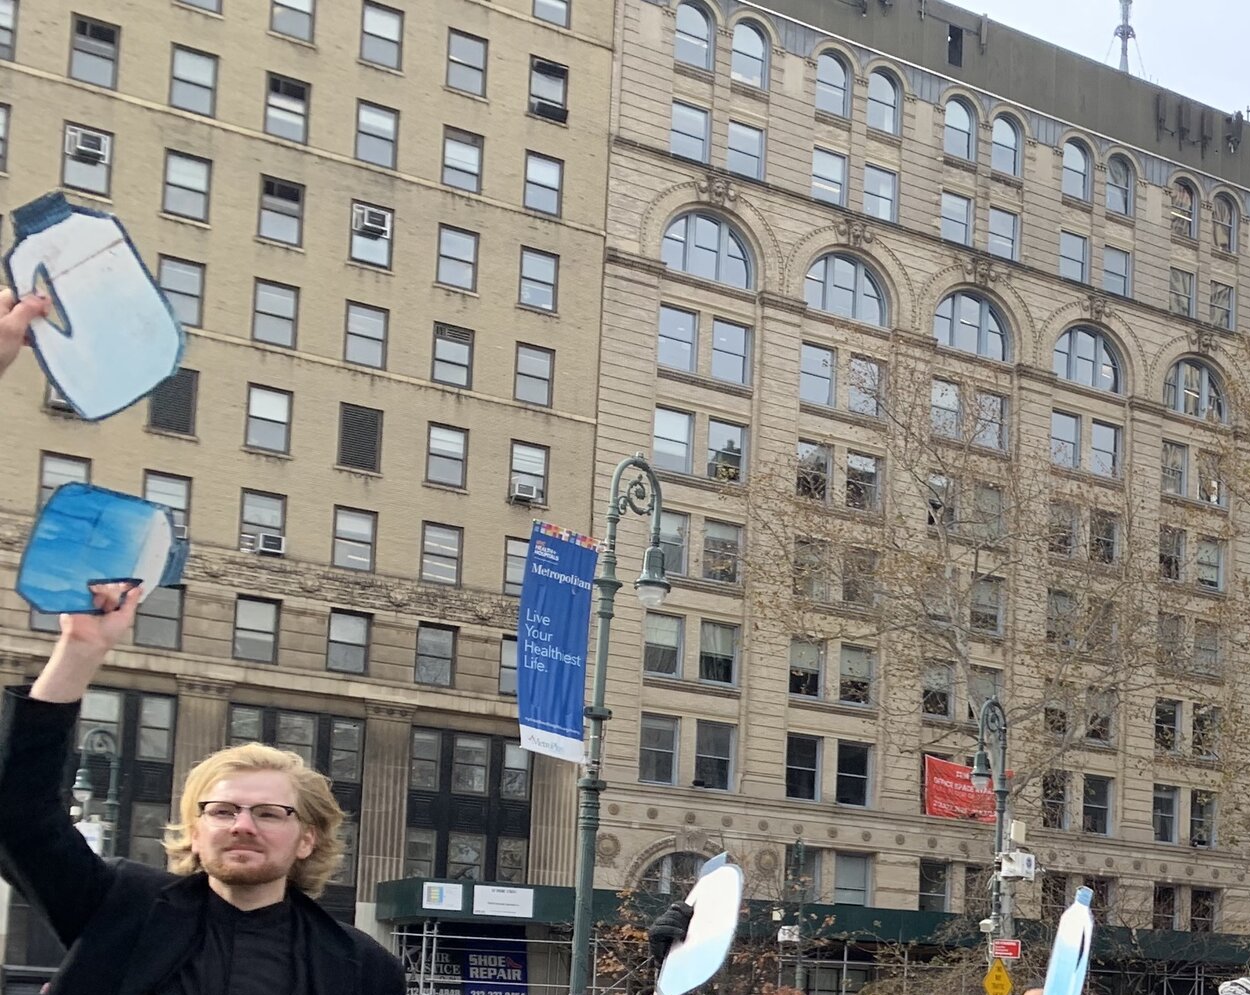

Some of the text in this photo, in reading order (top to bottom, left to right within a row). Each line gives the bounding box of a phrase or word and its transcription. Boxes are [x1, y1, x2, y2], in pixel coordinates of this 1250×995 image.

[531, 563, 591, 590] Metropolitan
[526, 608, 550, 626] Live
[525, 624, 553, 642] Your
[524, 639, 581, 667] Healthiest
[524, 655, 548, 673] Life.
[468, 954, 506, 968] SHOE
[469, 967, 522, 981] REPAIR
